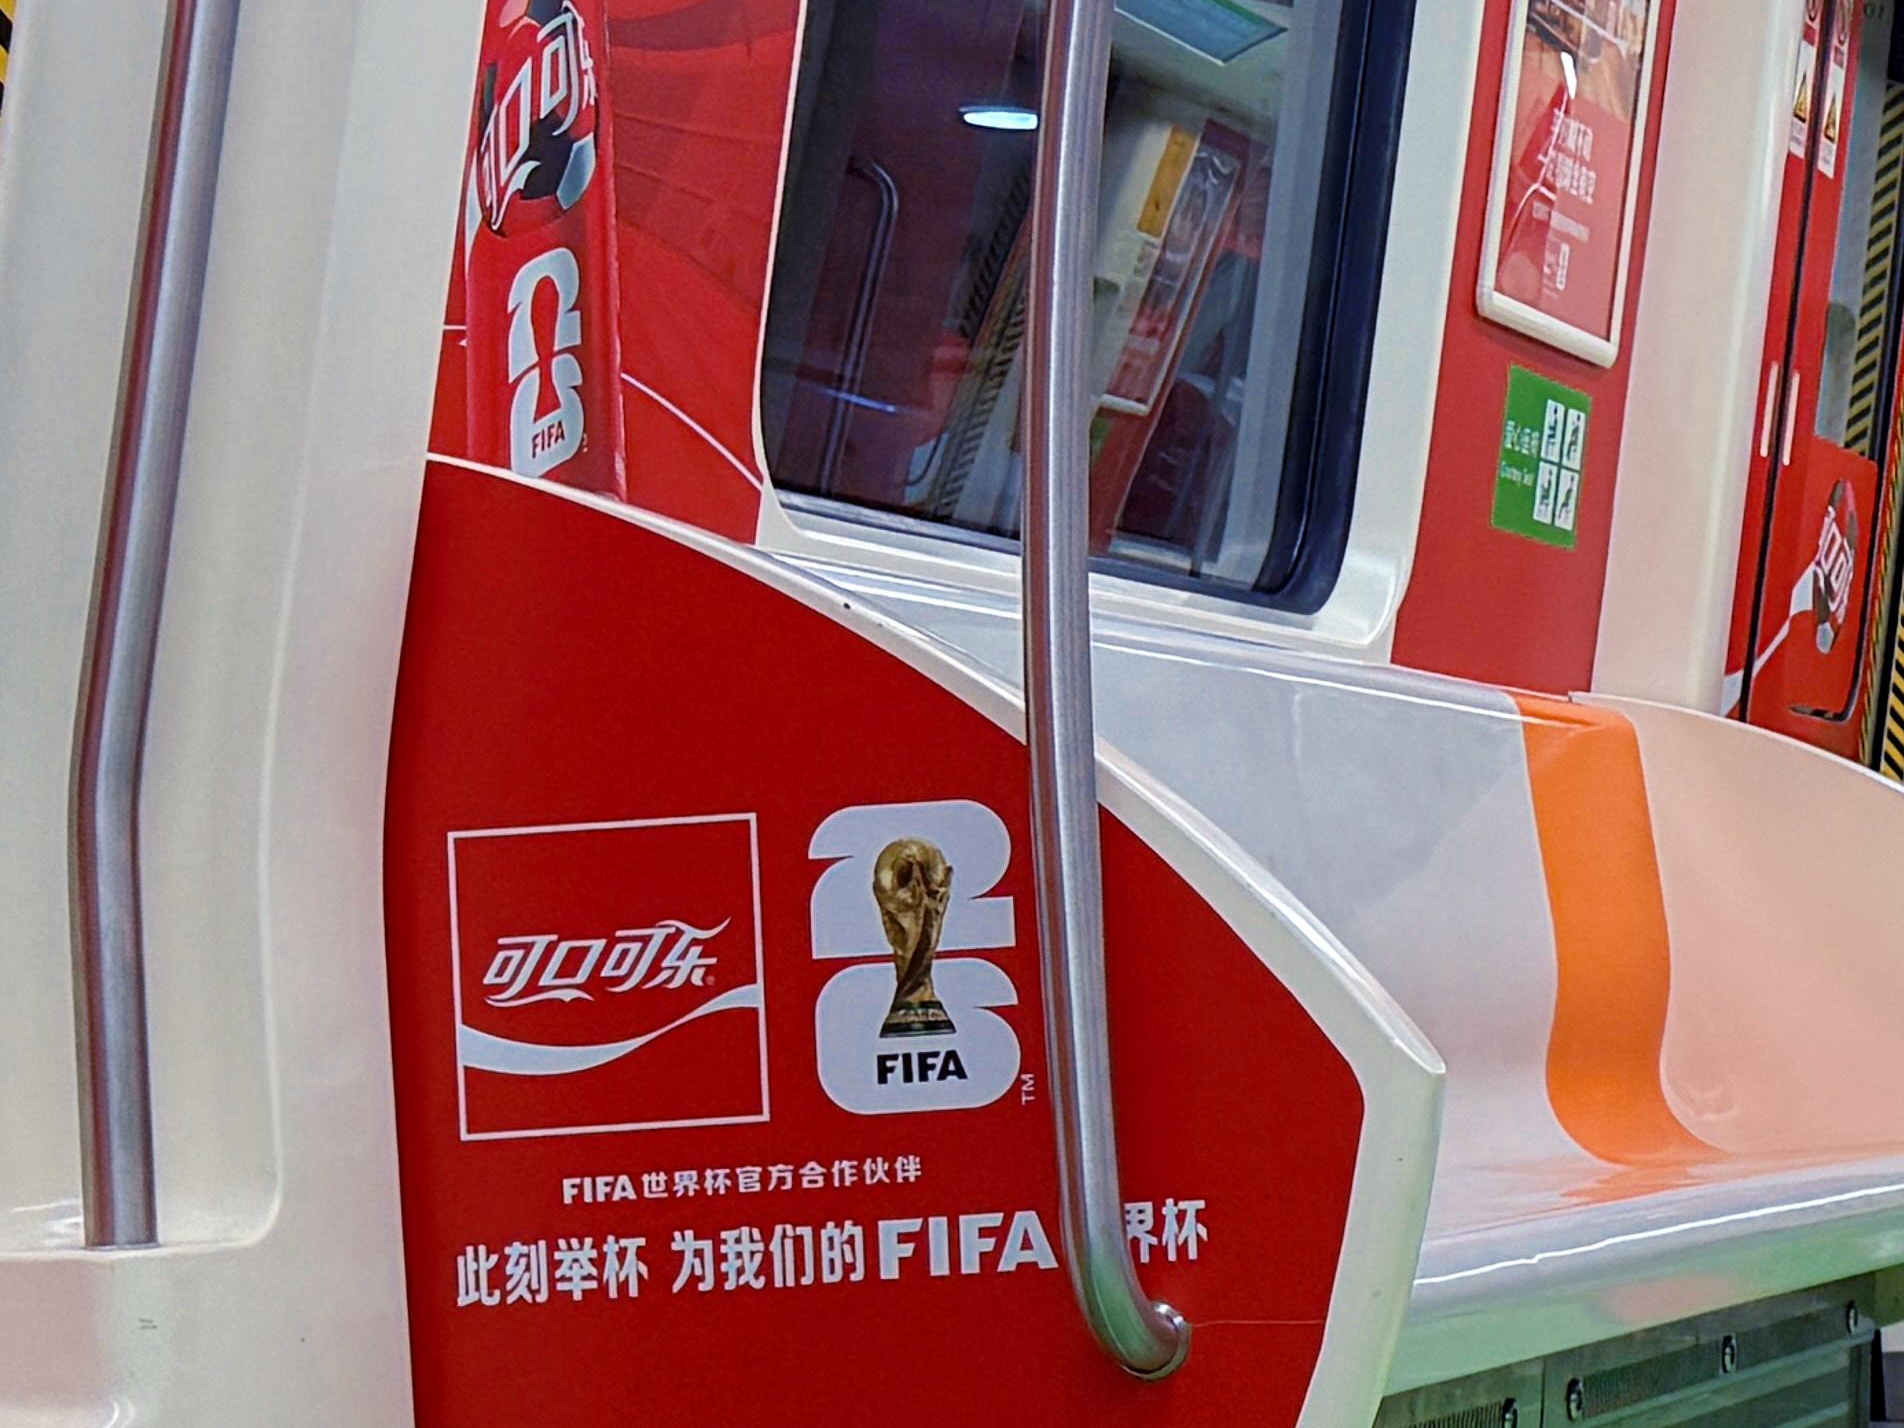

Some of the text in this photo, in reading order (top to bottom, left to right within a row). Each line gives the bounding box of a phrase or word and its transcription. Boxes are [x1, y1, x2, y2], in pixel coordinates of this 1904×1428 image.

[531, 419, 566, 459] FIFA
[482, 916, 731, 1008] 可口可乐
[876, 1049, 968, 1086] FIFA
[562, 1155, 923, 1204] FIFA世界杯官方合作伙伴
[456, 1198, 1210, 1309] 此刻举杯 为我们的FIFA界杯
